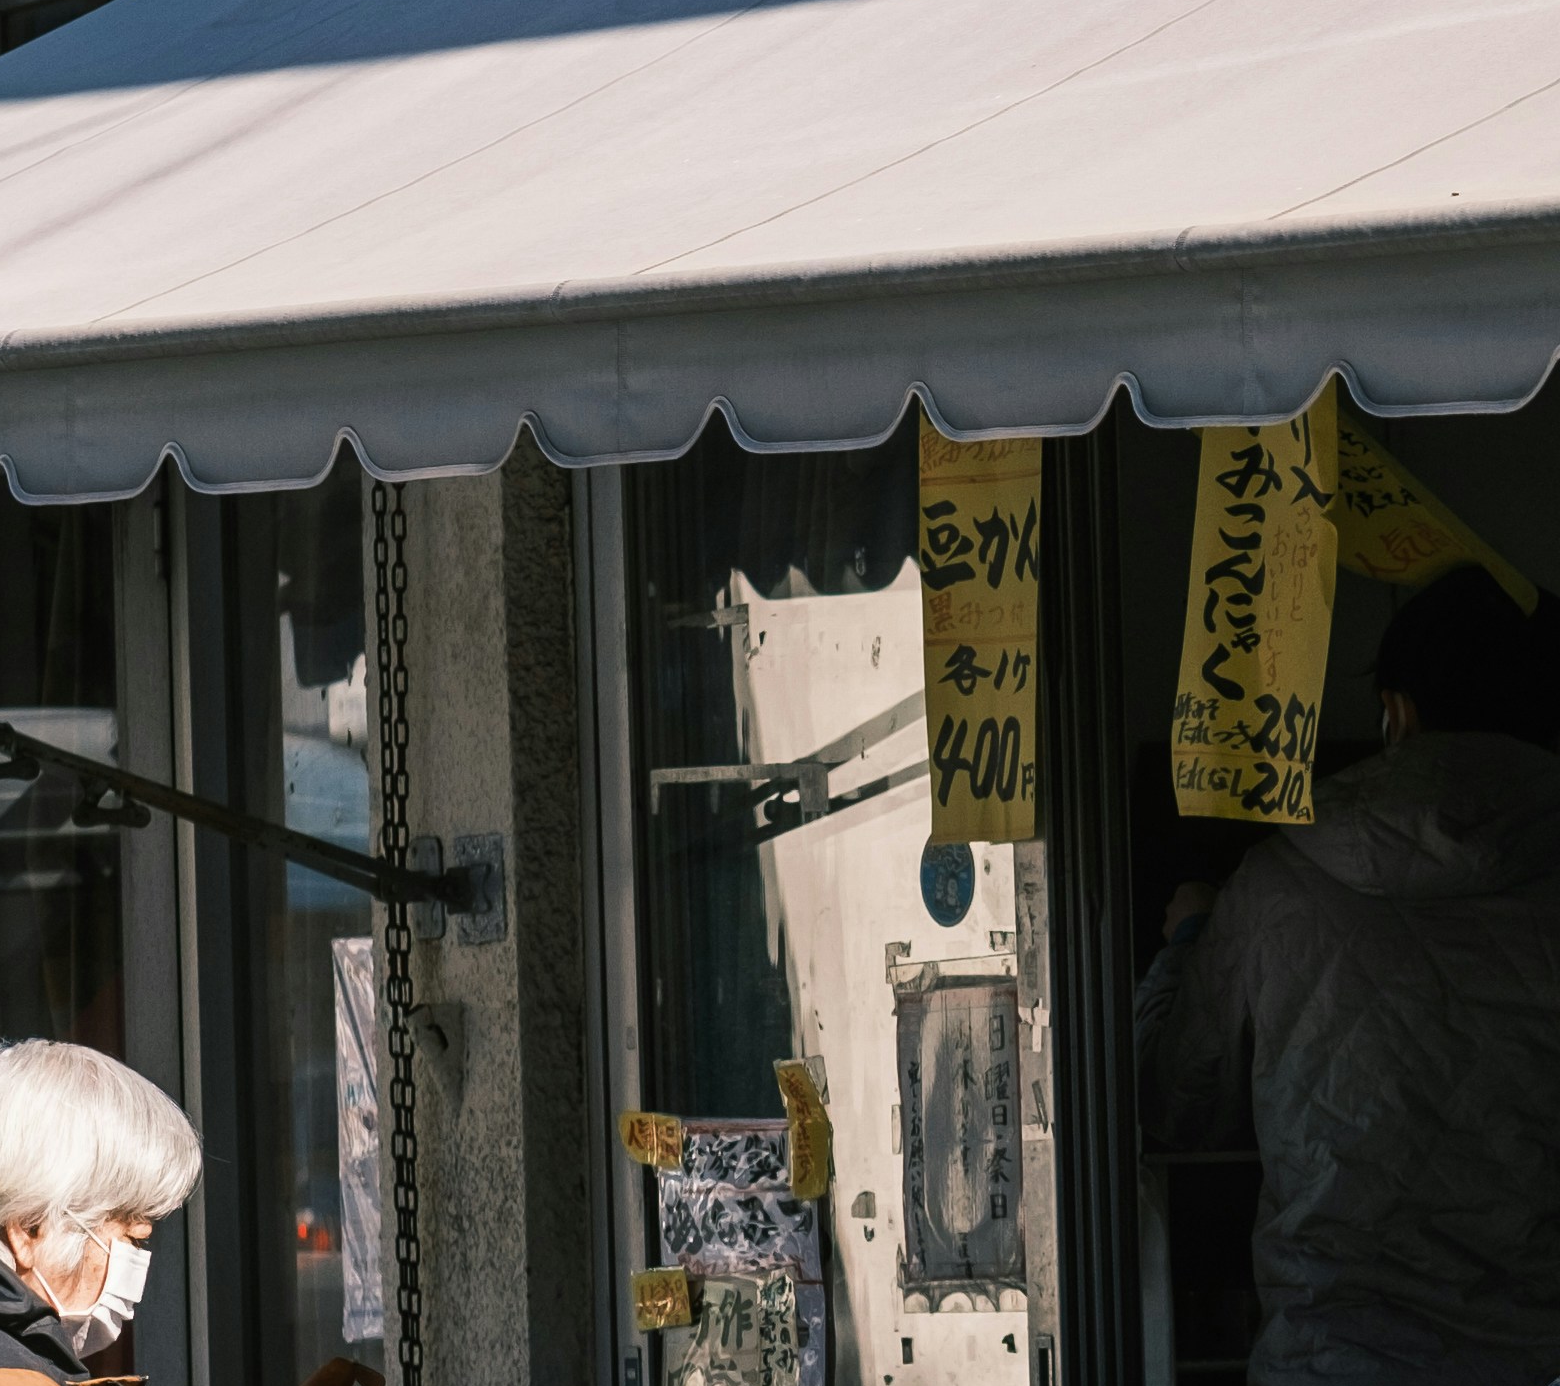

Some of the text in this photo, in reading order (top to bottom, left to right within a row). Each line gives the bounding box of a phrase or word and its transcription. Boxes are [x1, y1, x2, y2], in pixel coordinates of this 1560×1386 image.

[921, 497, 1038, 591] 豆かん
[1201, 425, 1284, 701] みこんにゃく
